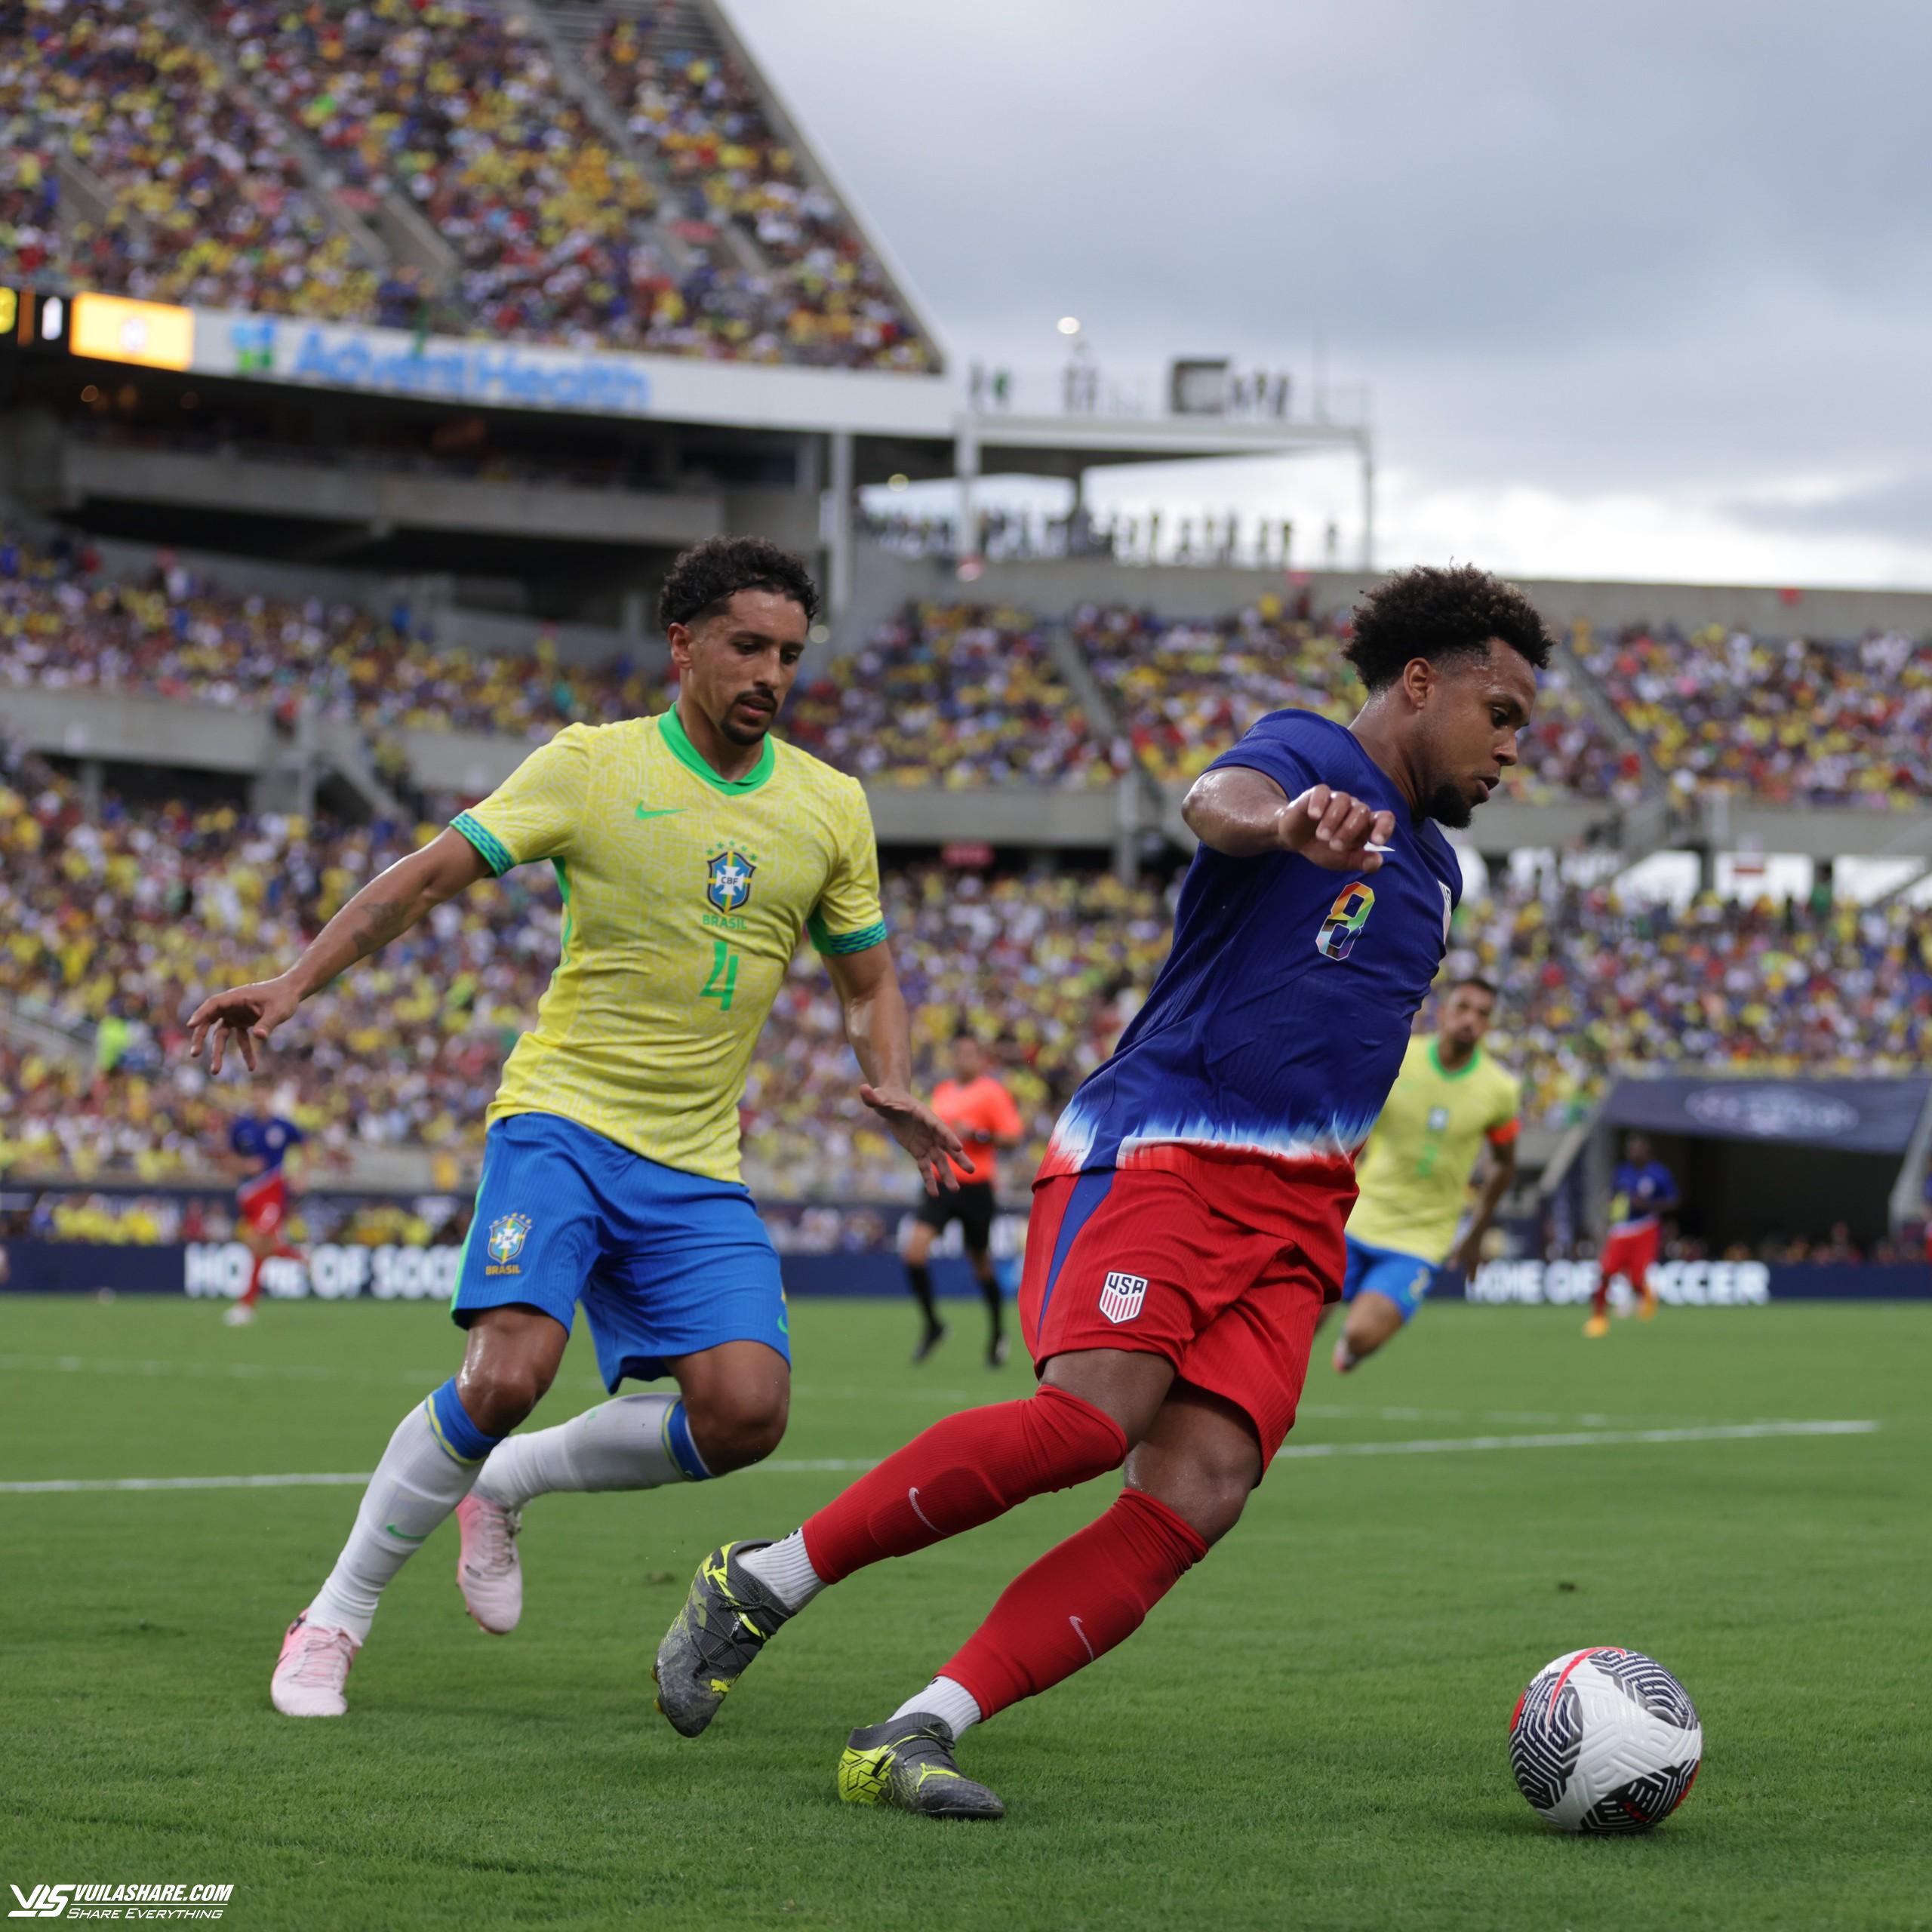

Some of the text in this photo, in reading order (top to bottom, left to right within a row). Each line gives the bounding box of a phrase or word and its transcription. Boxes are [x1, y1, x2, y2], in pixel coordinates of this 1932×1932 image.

[703, 914, 747, 930] BRASIL
[1315, 881, 1375, 961] 8
[699, 941, 739, 1011] 4
[311, 1243, 368, 1299] OF
[485, 1264, 521, 1275] BRASIL
[1108, 1275, 1145, 1295] USA
